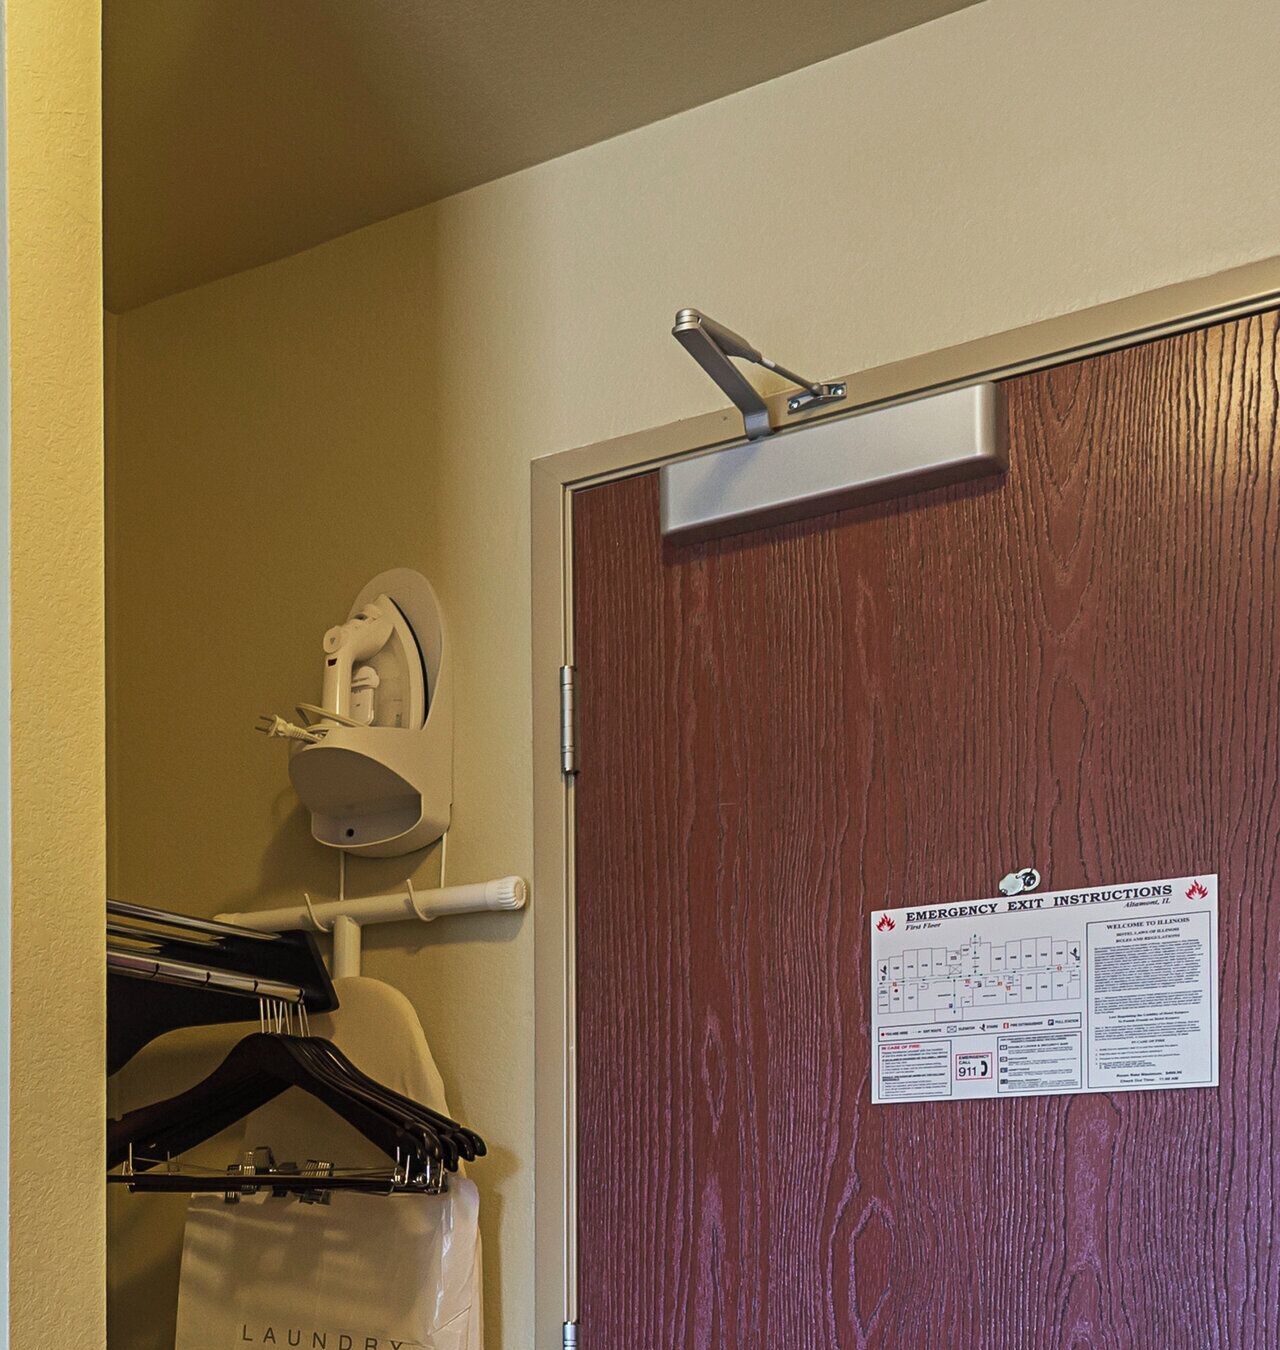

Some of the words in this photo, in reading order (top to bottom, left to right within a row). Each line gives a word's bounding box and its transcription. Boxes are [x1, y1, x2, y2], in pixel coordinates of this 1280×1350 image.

[907, 903, 998, 922] EMERGENCY
[1008, 898, 1044, 910] EXIT
[1053, 885, 1173, 907] INSTRUCTIONS
[1124, 899, 1160, 908] Altamont,
[1106, 922, 1144, 930] WELCOME
[1157, 917, 1191, 925] ILLINOIS
[959, 1066, 977, 1077] 911
